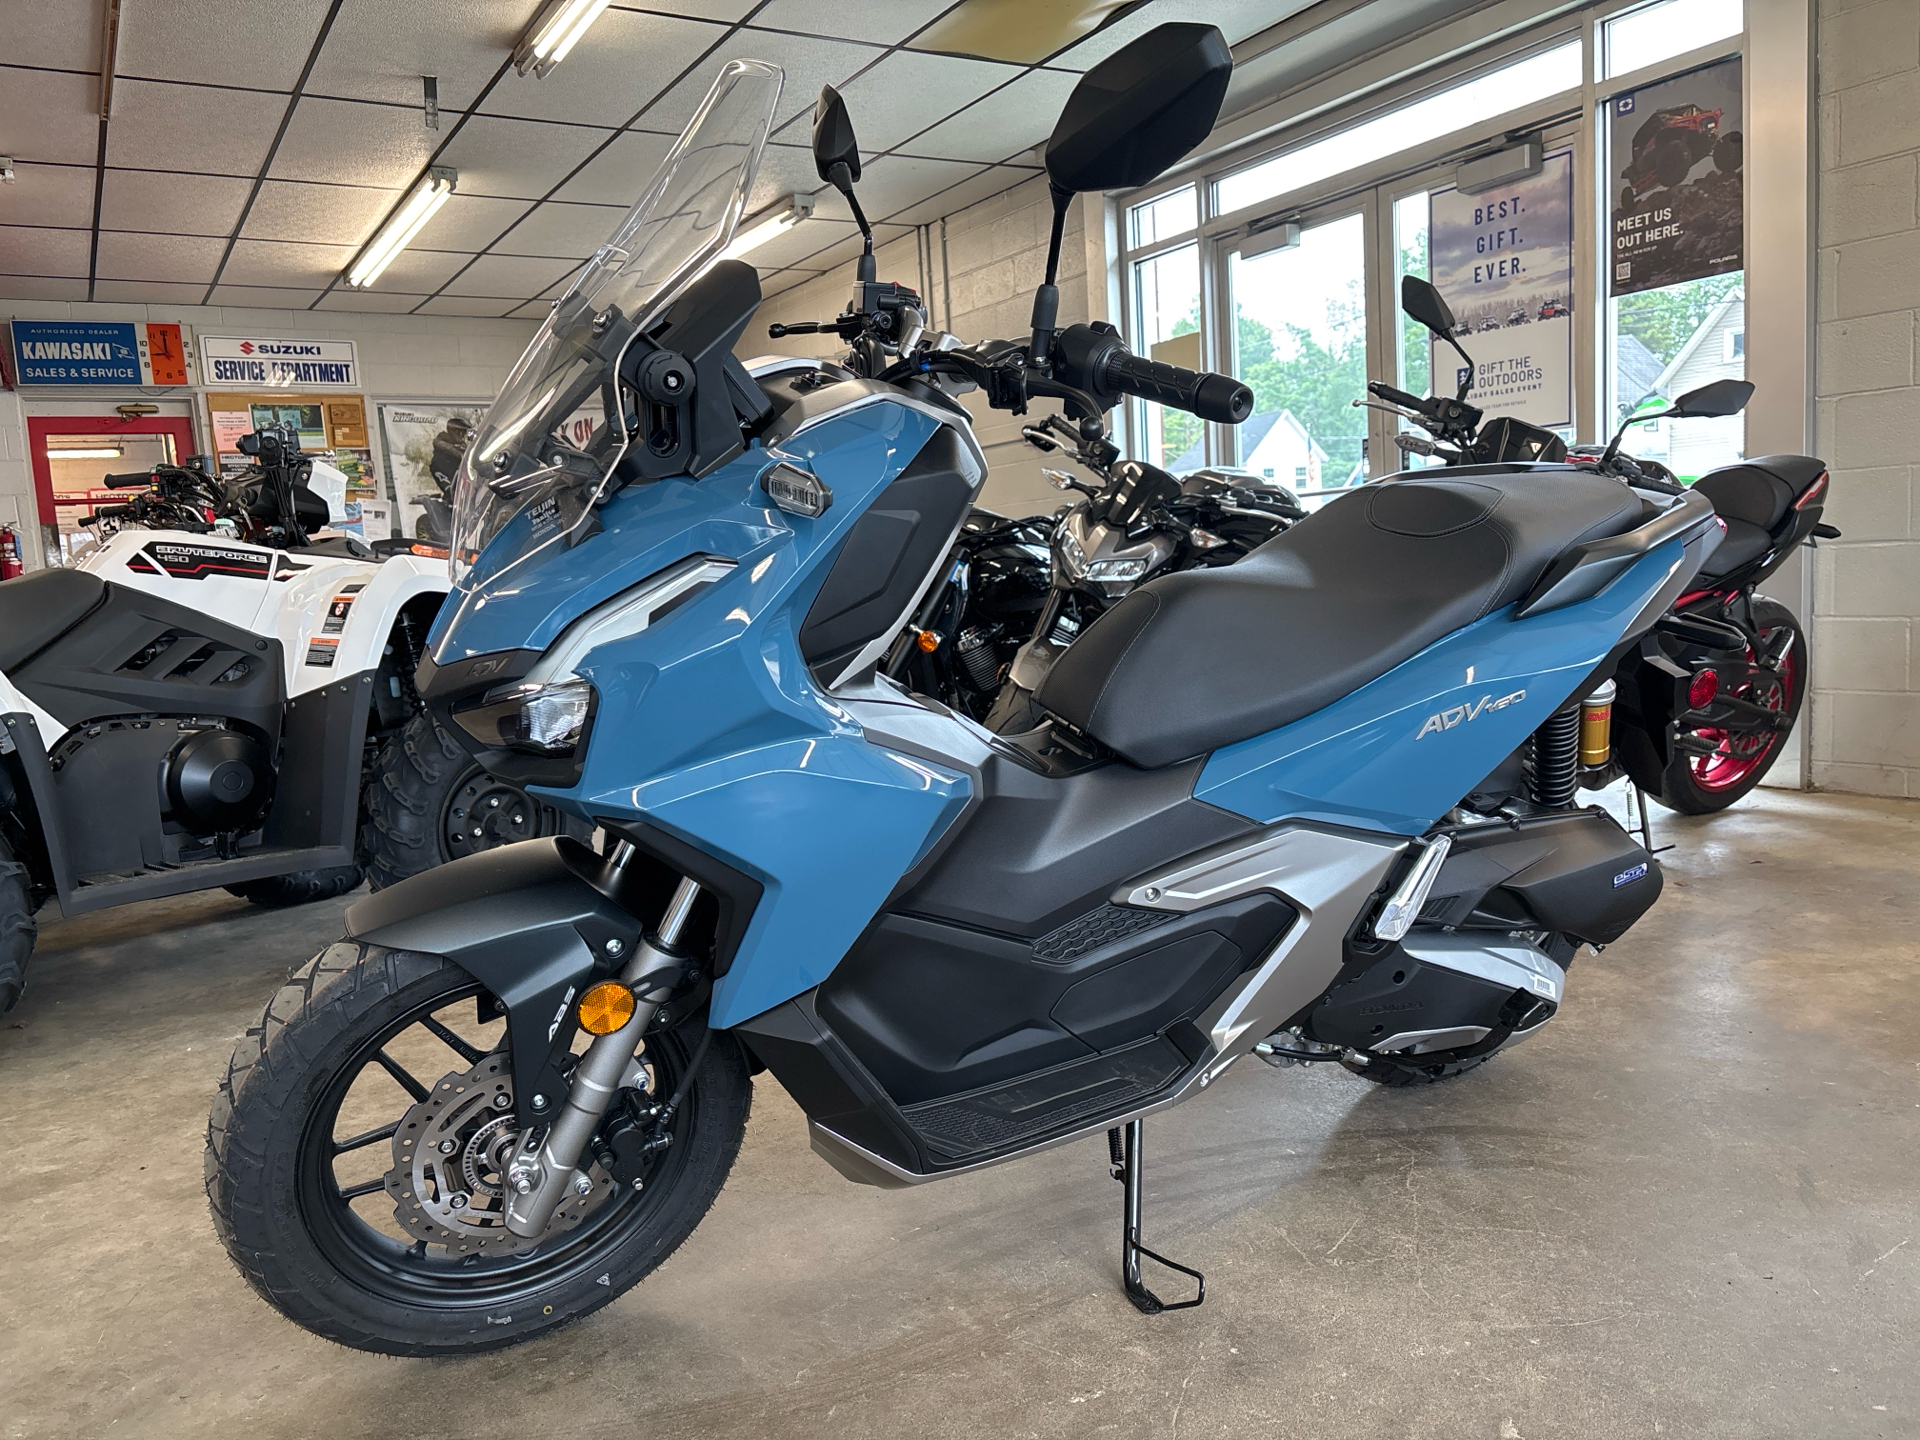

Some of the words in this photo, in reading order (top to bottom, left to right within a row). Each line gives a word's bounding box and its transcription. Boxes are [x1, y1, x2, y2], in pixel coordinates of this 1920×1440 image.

[1474, 196, 1526, 226] BEST.
[1616, 212, 1652, 232] MEET
[1654, 208, 1672, 222] US
[1476, 227, 1524, 254] GIFT.
[1616, 232, 1642, 250] OUT
[1646, 222, 1684, 243] HERE.
[1709, 254, 1738, 264] POLARIS
[1474, 256, 1526, 284] EVER.
[22, 342, 112, 360] KAWASAKI
[258, 344, 322, 355] SUZUKI
[26, 368, 66, 378] SALES
[70, 368, 79, 378] &
[81, 368, 135, 378] SERVICE
[214, 360, 265, 380] SERVICE
[272, 362, 350, 382] DEPARTMENT
[1478, 360, 1505, 376] GIFT
[1508, 356, 1531, 370] THE
[1478, 368, 1542, 388] OUTDOORS
[1466, 392, 1488, 400] LIDAY
[1490, 388, 1514, 396] SALES
[1517, 383, 1542, 392] EVENT
[525, 496, 556, 520] TEIJIN
[532, 524, 556, 539] HONDA
[157, 554, 189, 563] 450
[466, 657, 510, 678] ADV
[548, 986, 576, 1043] ABS
[1359, 1000, 1424, 1016] HONDA
